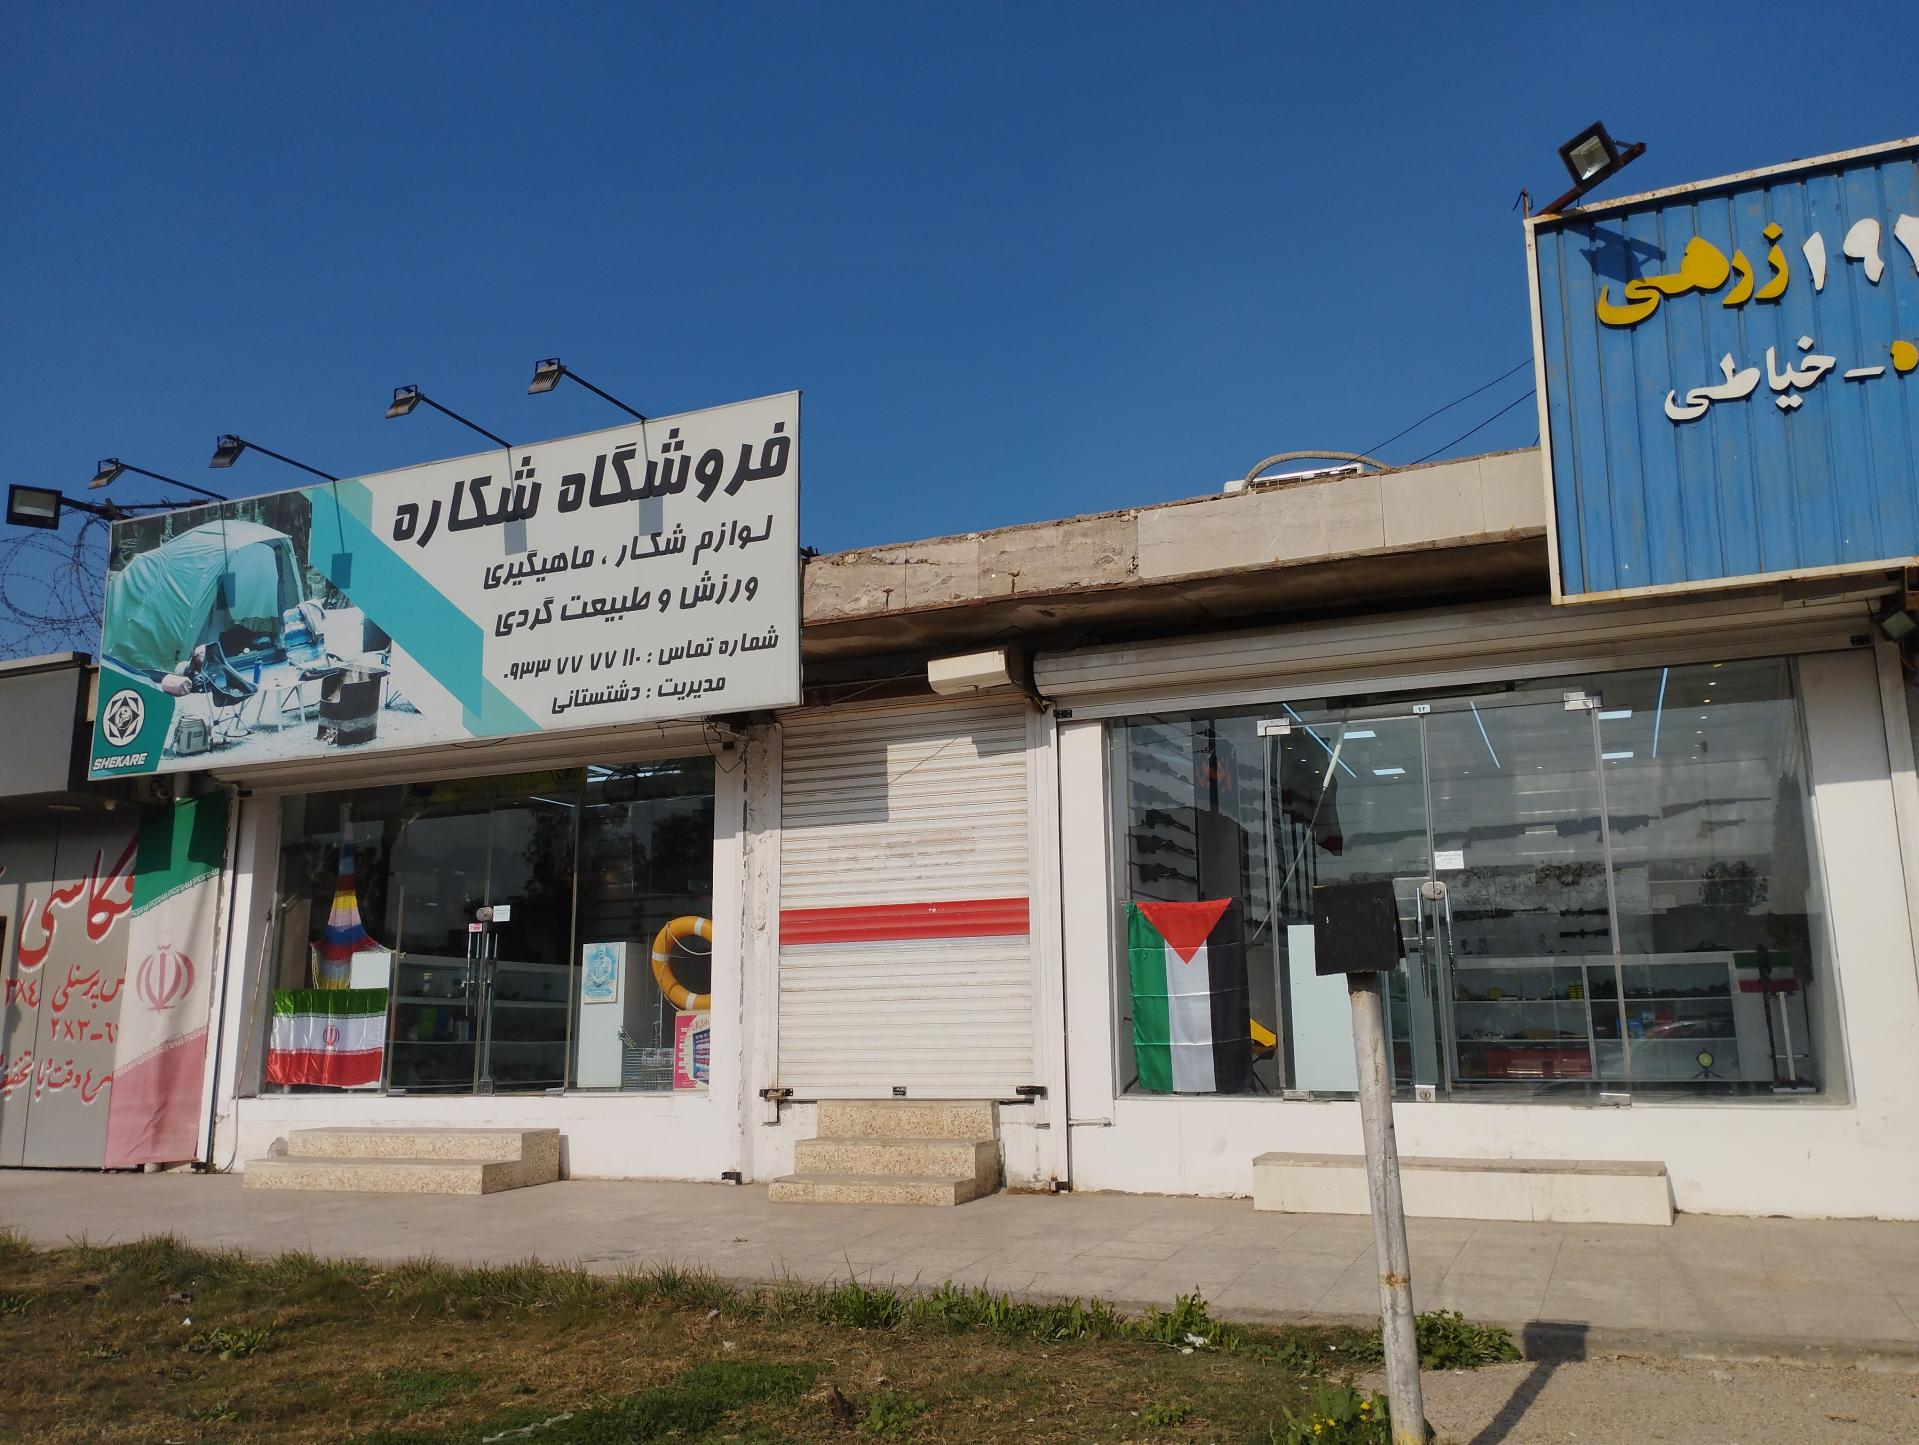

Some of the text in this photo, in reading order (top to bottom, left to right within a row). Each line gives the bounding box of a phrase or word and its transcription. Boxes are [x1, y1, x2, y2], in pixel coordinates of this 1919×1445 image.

[1597, 223, 1789, 325] زرهی
[1664, 336, 1836, 420] خیاطی
[392, 421, 791, 548] فروشگاه شکاره
[615, 523, 687, 568] شکار
[692, 514, 774, 566] لوازم
[483, 545, 595, 590] ماهیگیری
[494, 570, 759, 638] ورزش و طبیعت گردی
[658, 637, 713, 666] تماس
[718, 625, 779, 658] شماره
[503, 658, 551, 680] ۰۹۳۳
[657, 676, 726, 701] مدیریت
[551, 679, 640, 715] دشتستانی
[92, 752, 147, 771] SHEKARE
[17, 830, 138, 970] کاسی
[51, 963, 100, 1012] پرسنلی
